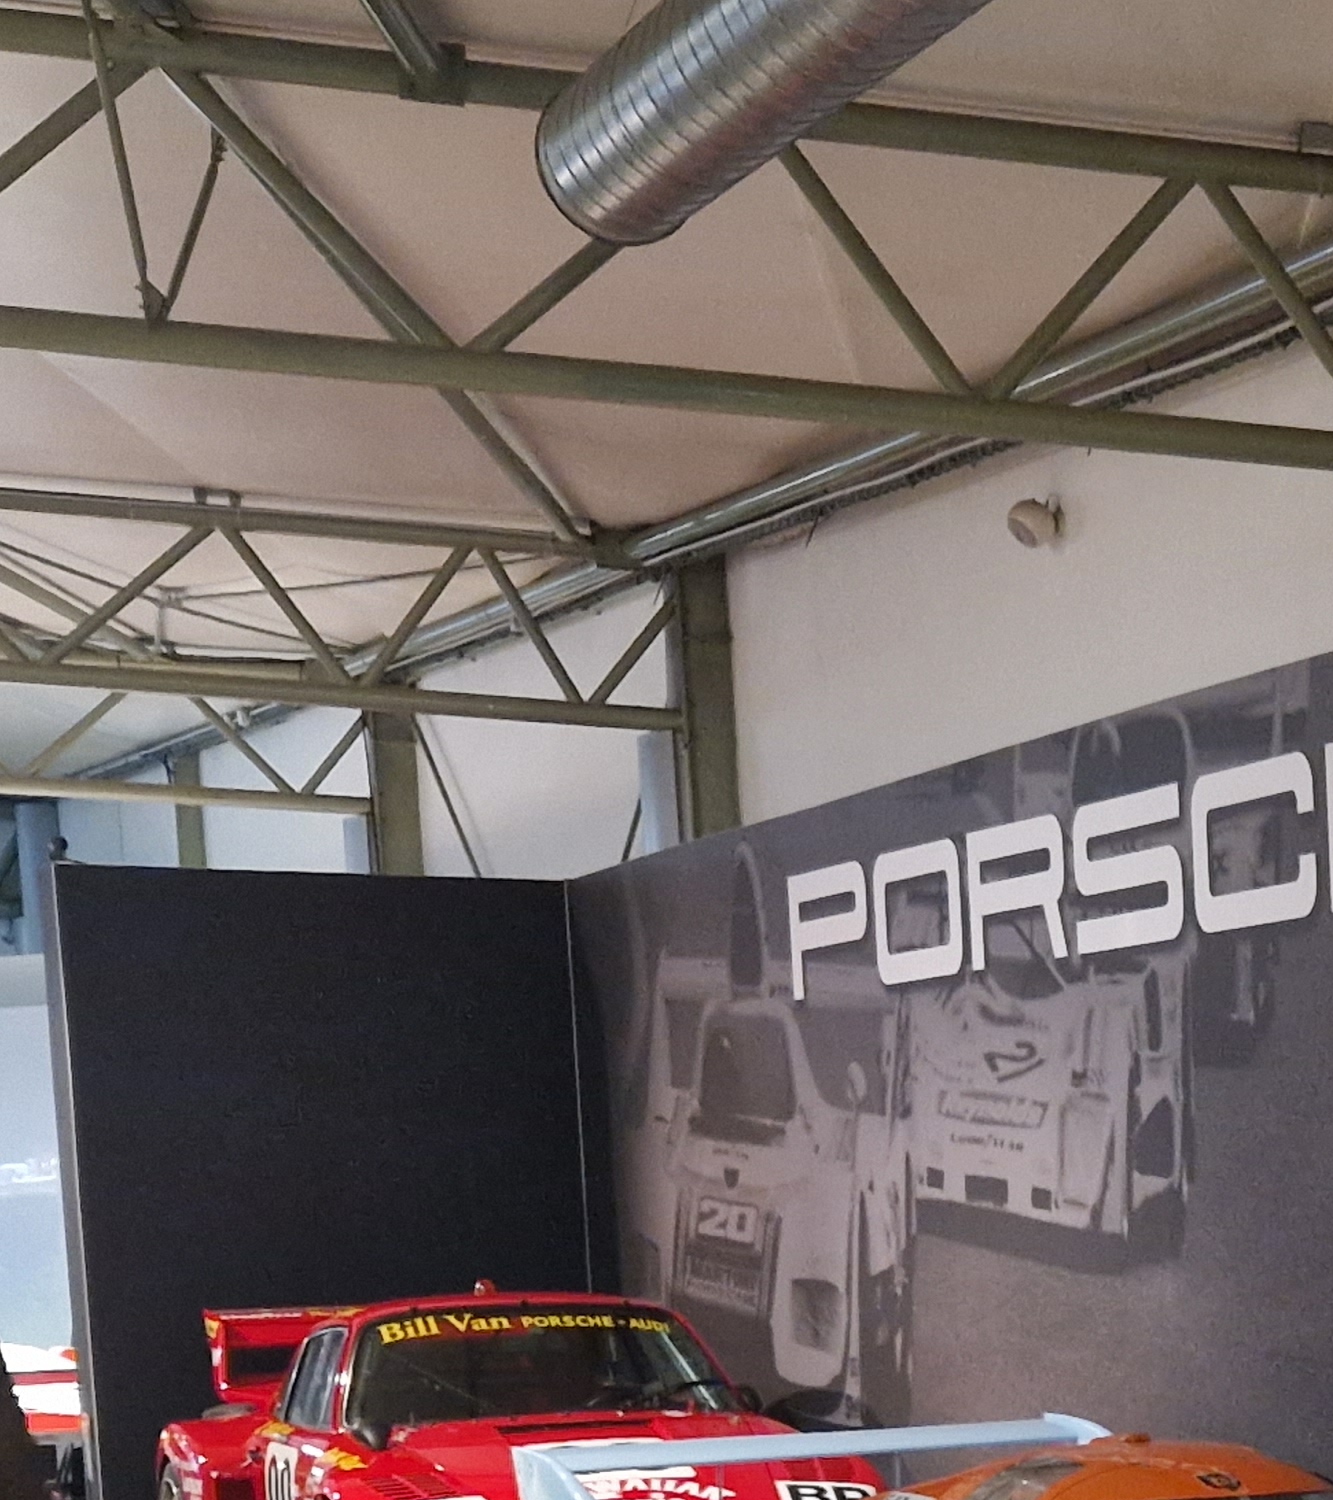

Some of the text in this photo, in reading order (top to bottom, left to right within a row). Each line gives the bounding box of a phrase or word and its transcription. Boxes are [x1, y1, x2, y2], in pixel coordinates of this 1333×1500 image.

[377, 1315, 441, 1345] Bill
[444, 1312, 512, 1334] Van
[520, 1315, 615, 1329] PORSCHE
[628, 1317, 670, 1334] AUDI
